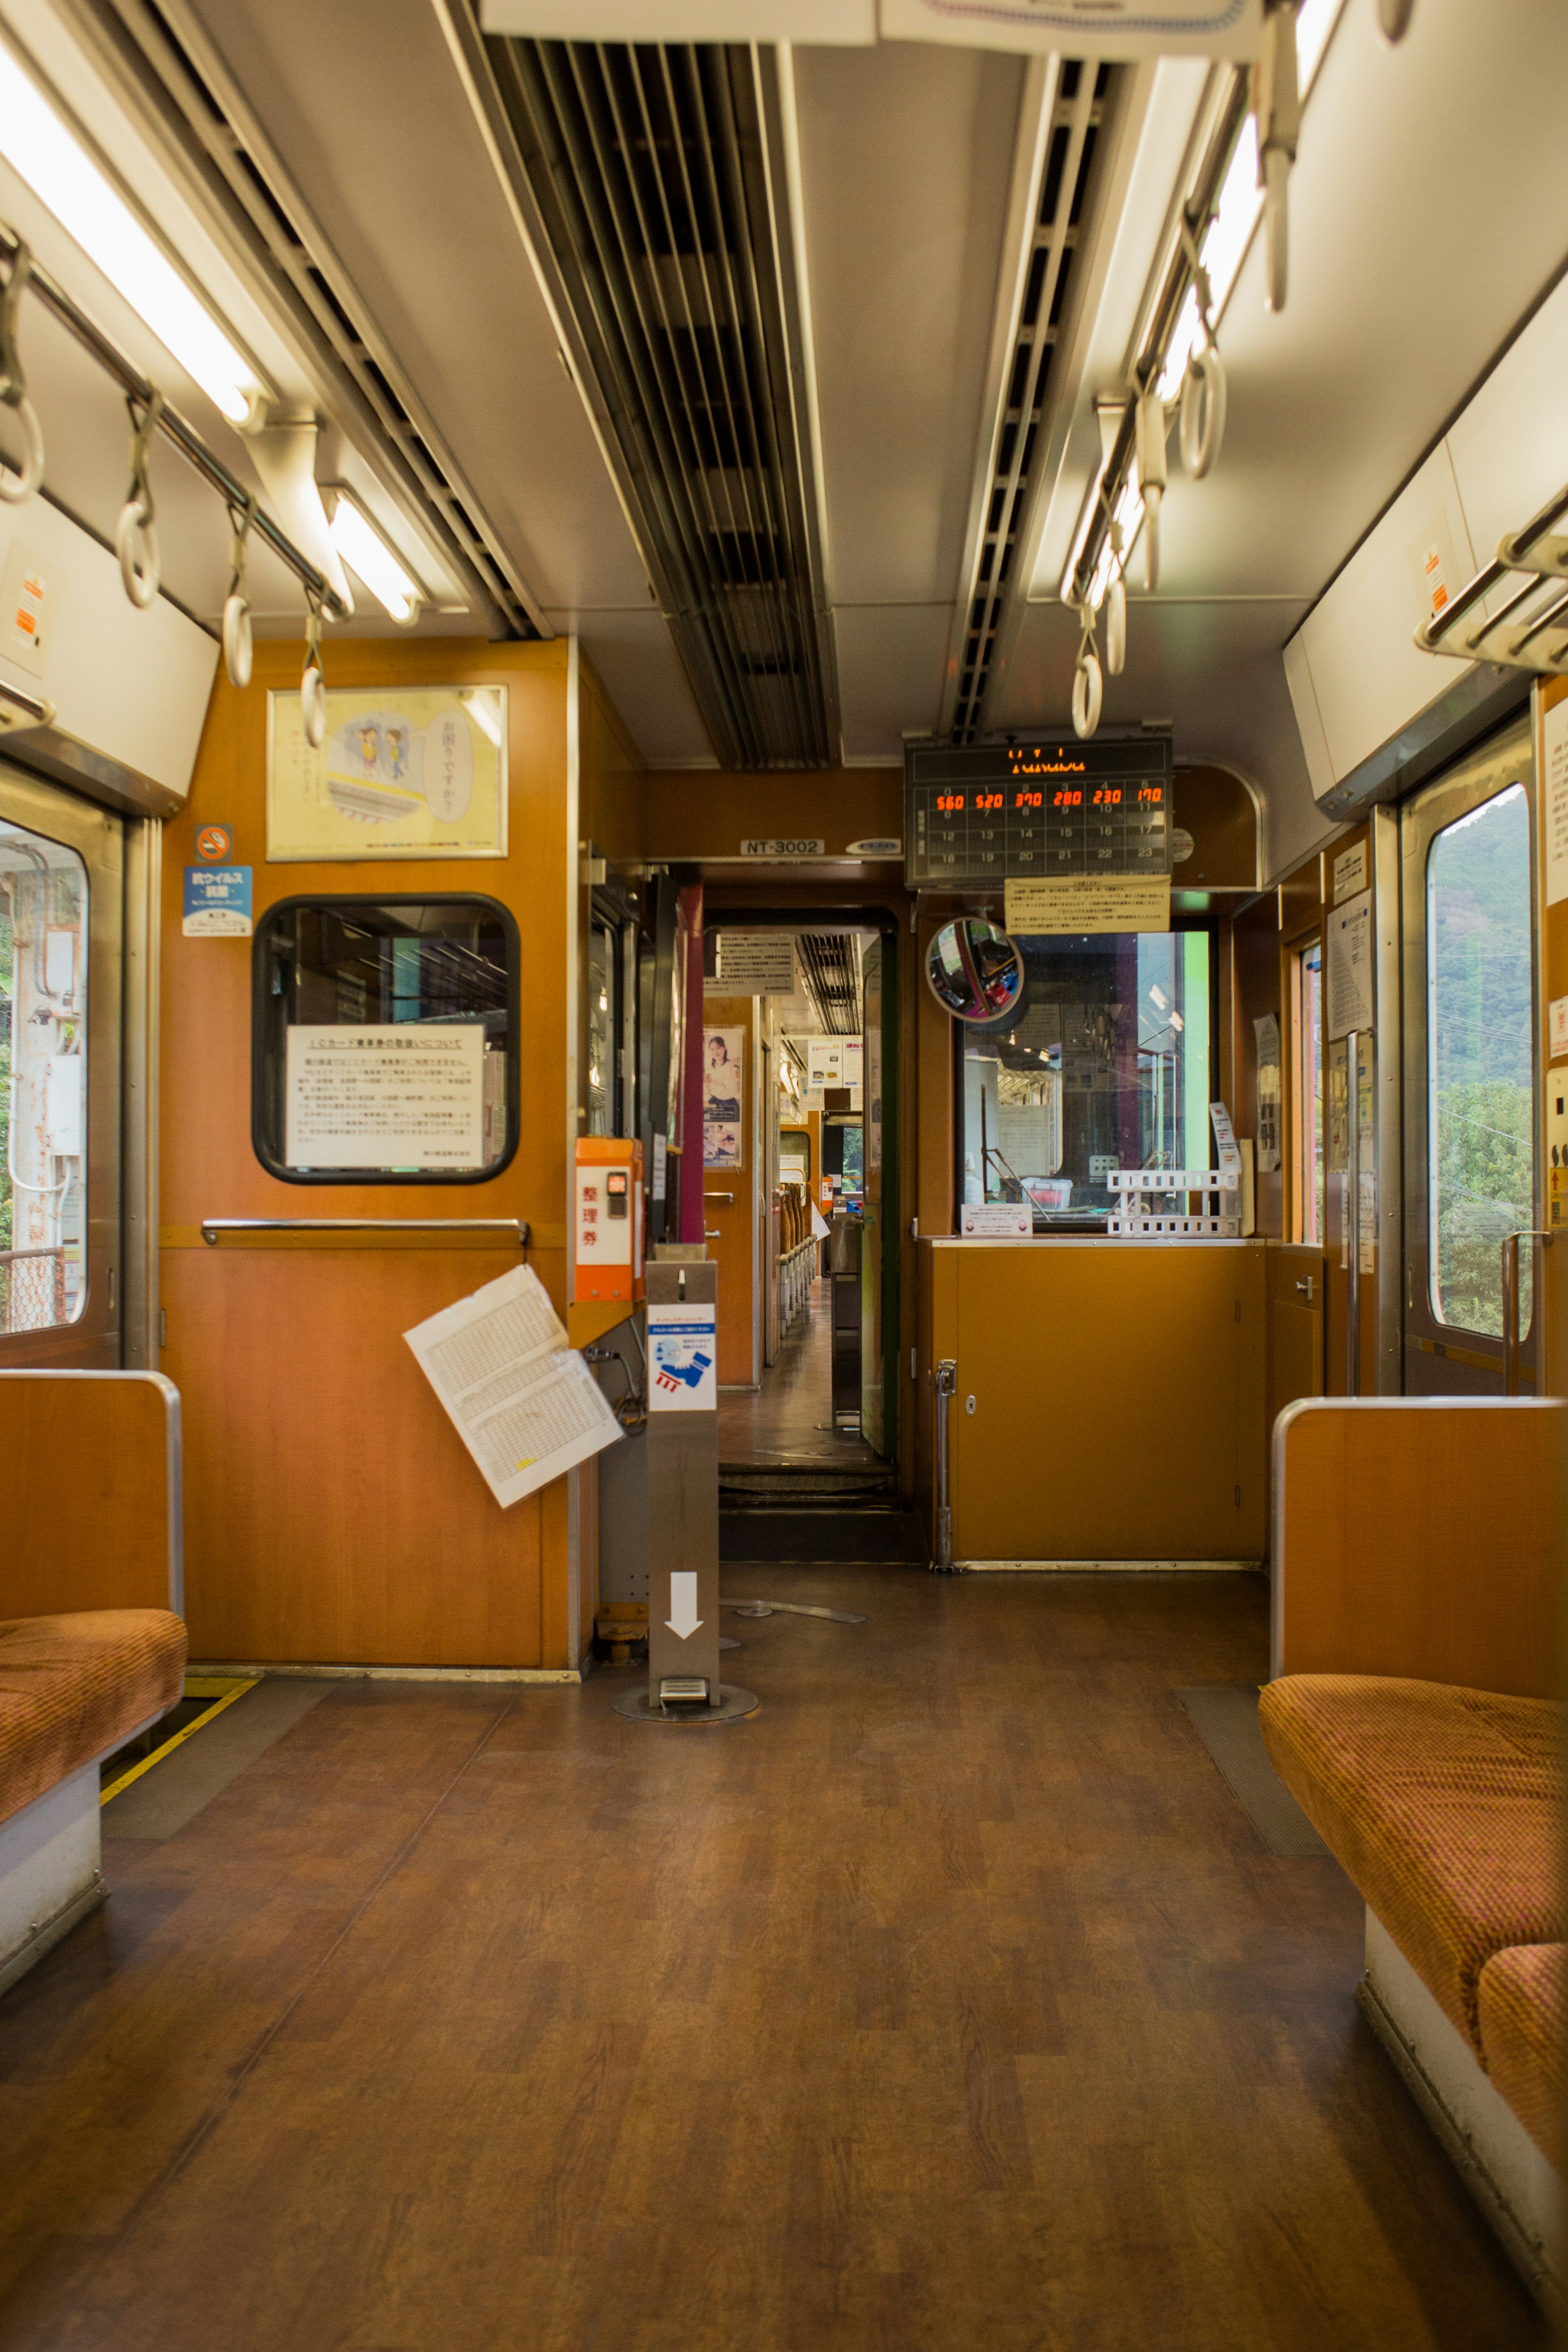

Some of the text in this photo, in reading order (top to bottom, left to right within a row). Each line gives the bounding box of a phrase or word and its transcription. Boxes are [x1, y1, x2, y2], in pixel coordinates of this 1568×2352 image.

[985, 786, 989, 794] 1
[1101, 781, 1108, 790] 4
[944, 787, 951, 796] 0
[1138, 787, 1162, 802] 170
[976, 794, 1003, 808] 520
[1015, 793, 1042, 807] 370
[1054, 791, 1082, 806] 280
[1093, 789, 1122, 804] 230
[937, 795, 964, 810] 560
[1140, 803, 1150, 811] 11
[983, 809, 990, 817] 7
[1062, 806, 1069, 815] 9
[1099, 804, 1112, 813] 10
[944, 810, 951, 819] 6
[1020, 829, 1033, 838] 14
[1060, 828, 1072, 837] 15
[1099, 826, 1112, 835] 16
[1140, 826, 1152, 834] 17
[943, 832, 954, 841] 12
[982, 831, 993, 840] 13
[747, 841, 818, 853] NT-3002
[1019, 852, 1033, 861] 20
[1058, 851, 1071, 860] 21
[1098, 849, 1112, 858] 22
[1138, 848, 1152, 857] 23
[943, 854, 955, 863] 18
[982, 853, 994, 862] 19
[583, 1187, 597, 1246] 整理券
